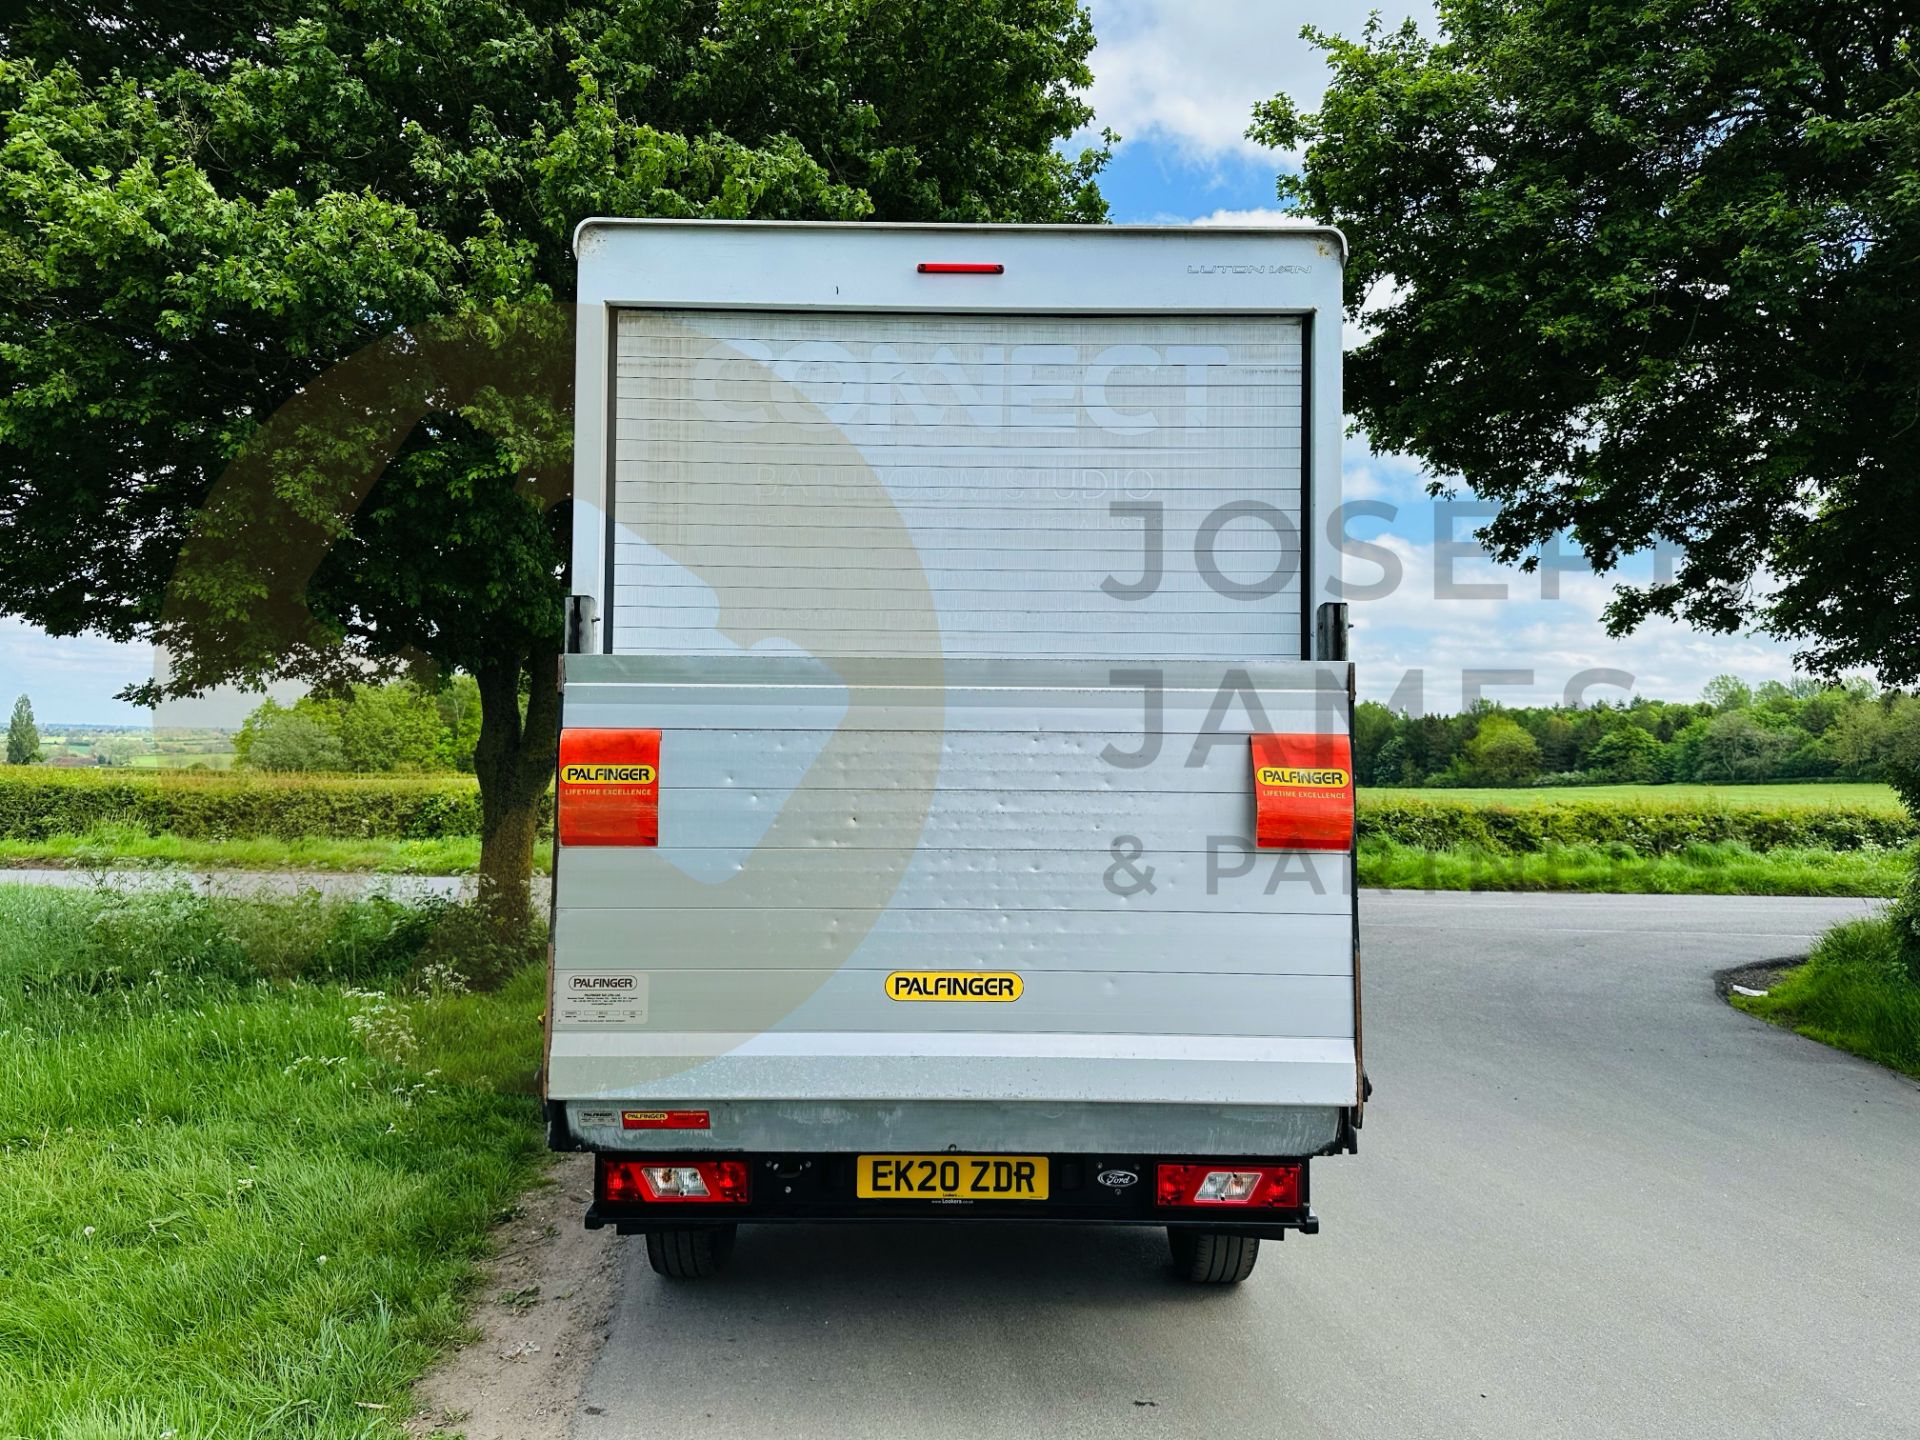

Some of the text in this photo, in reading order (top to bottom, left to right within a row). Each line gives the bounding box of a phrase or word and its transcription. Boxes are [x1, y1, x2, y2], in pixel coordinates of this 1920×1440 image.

[1187, 265, 1312, 274] LUTON VAN
[693, 341, 1229, 436] CONNECT
[1006, 468, 1154, 500] STUDIO
[567, 768, 650, 781] PALFINGER
[1263, 770, 1344, 785] PALFINGER
[1298, 791, 1346, 799] EXCELLENCE
[573, 978, 632, 988] PALFINGER
[894, 977, 1014, 996] PALFINGER
[872, 1160, 1035, 1193] EK20 ZDR
[1106, 1173, 1130, 1184] Ford
